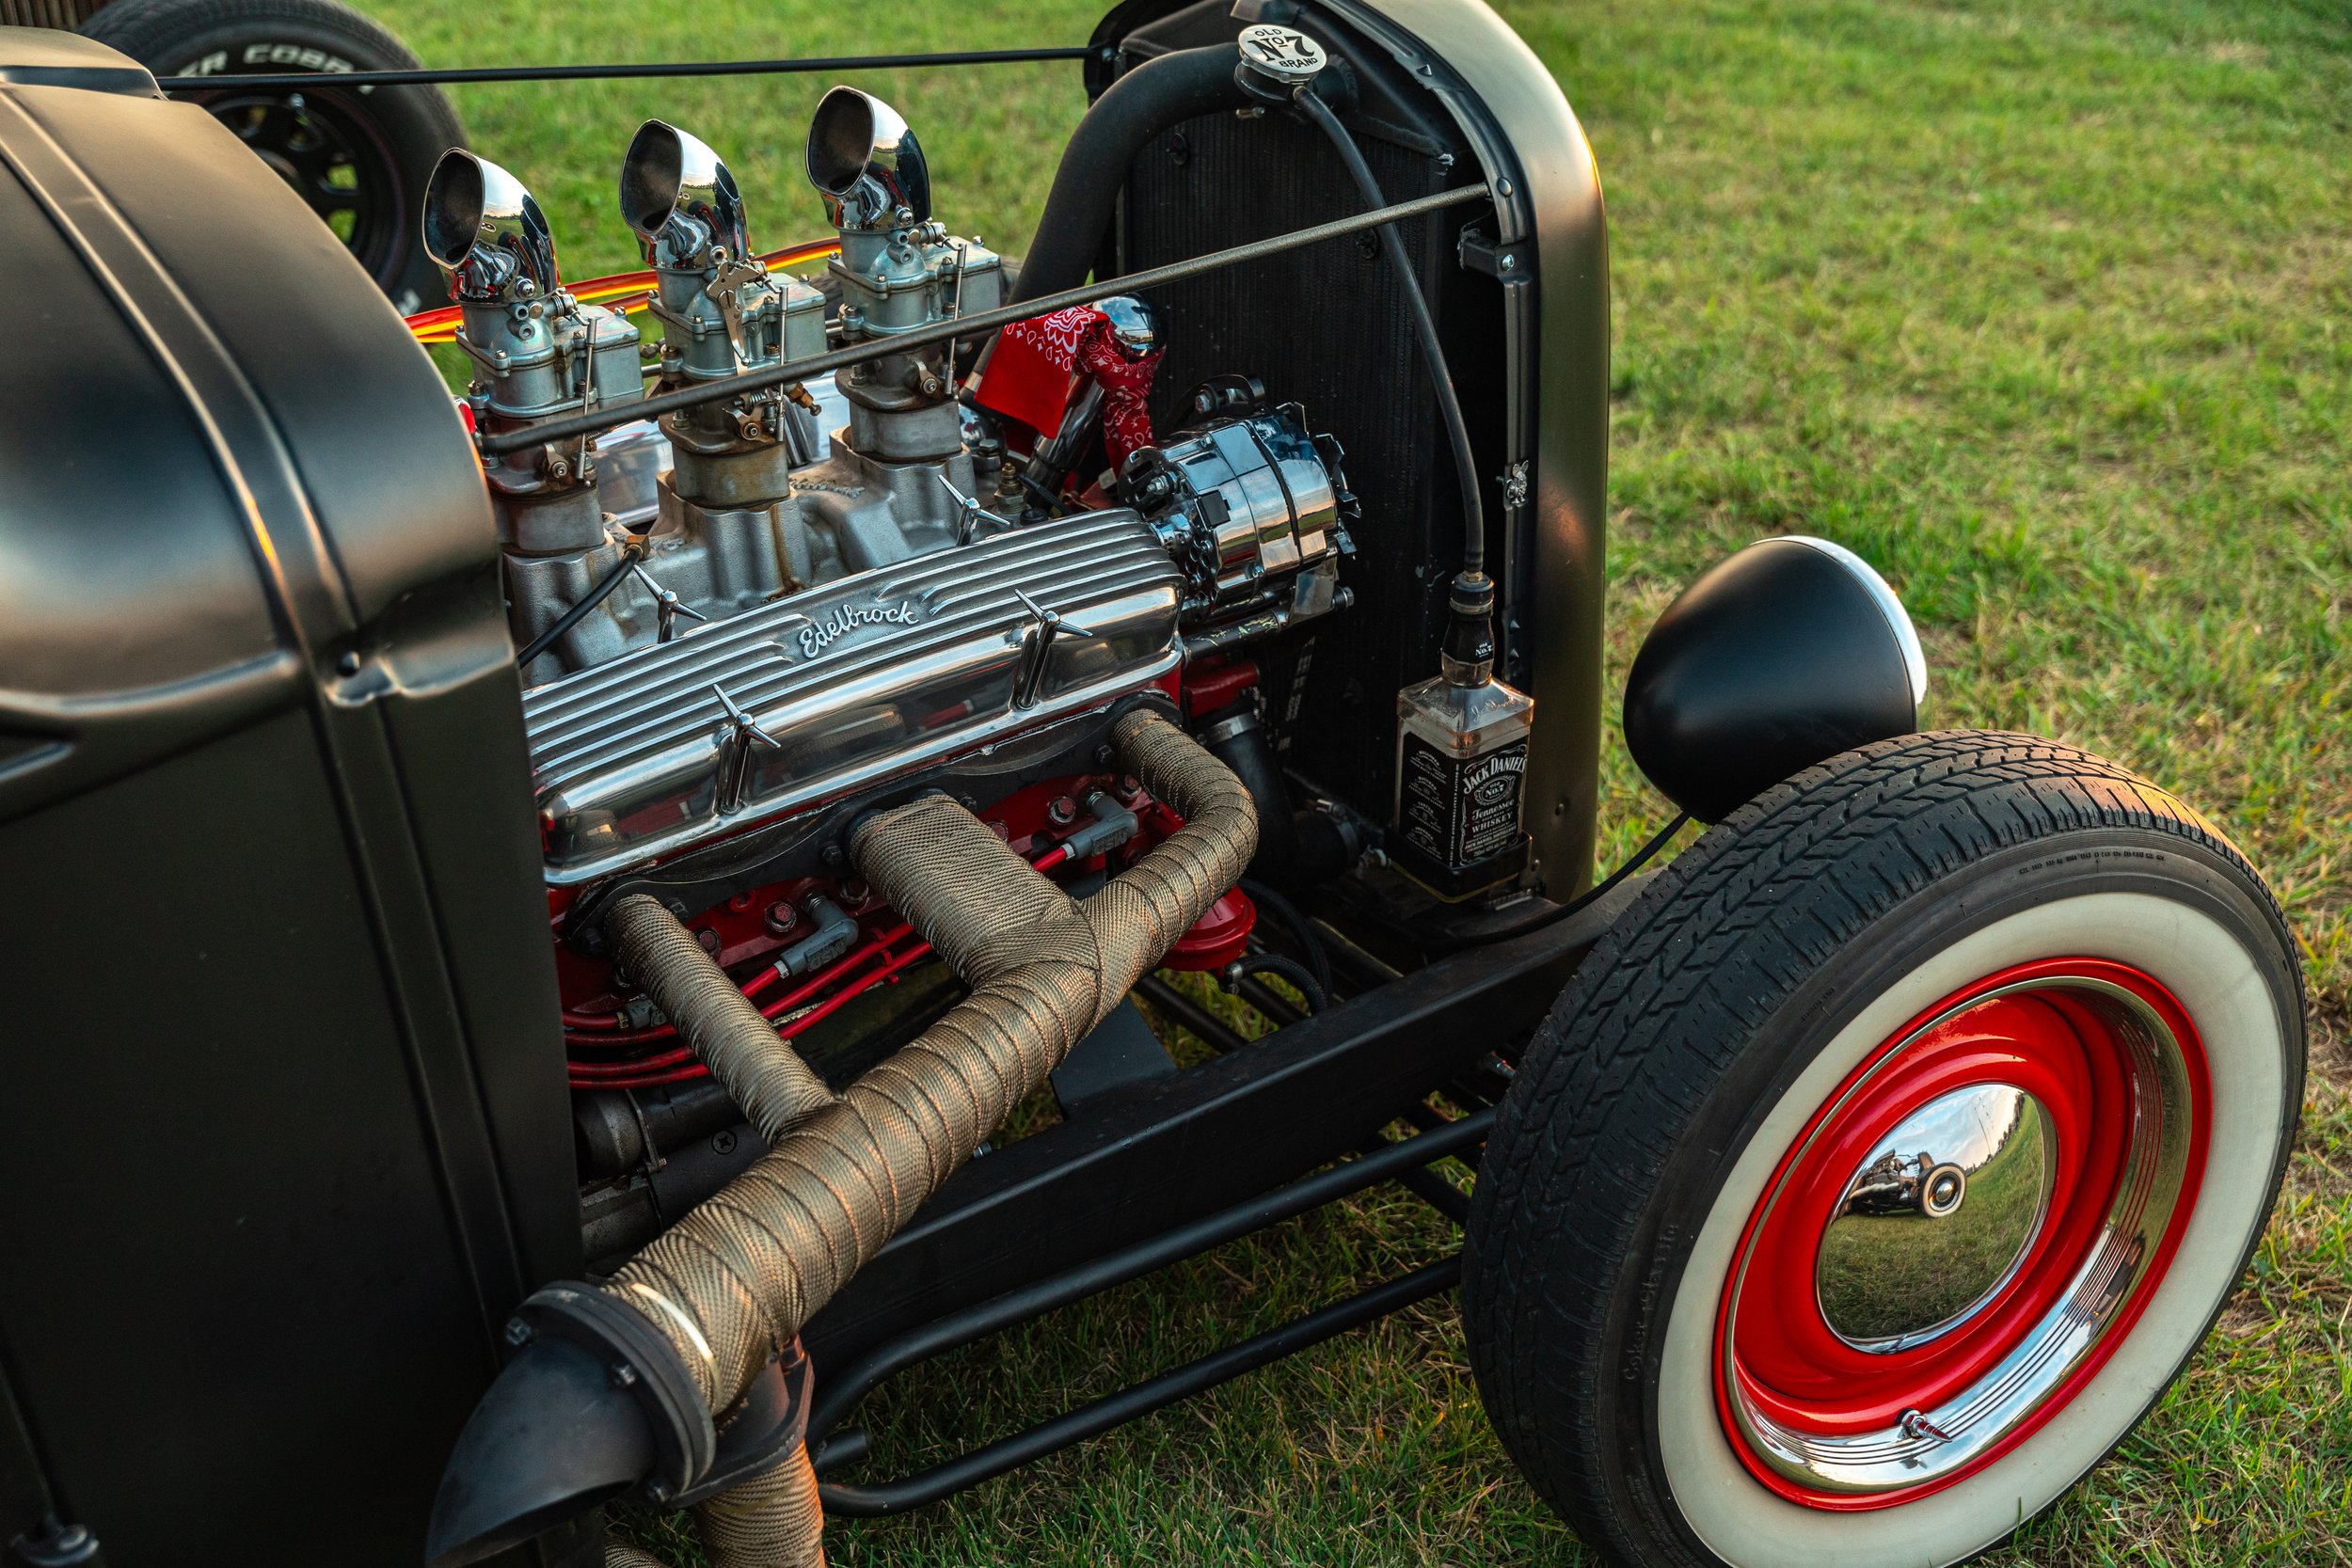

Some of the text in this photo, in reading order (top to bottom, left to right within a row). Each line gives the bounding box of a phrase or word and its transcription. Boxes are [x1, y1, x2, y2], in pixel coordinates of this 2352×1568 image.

[1254, 28, 1282, 38] OLD
[1279, 57, 1318, 69] BRAND
[799, 601, 919, 658] Edelbrock
[1463, 765, 1490, 795] JACK
[1471, 799, 1515, 821] Tennessee
[1471, 811, 1513, 833] WHISKEY
